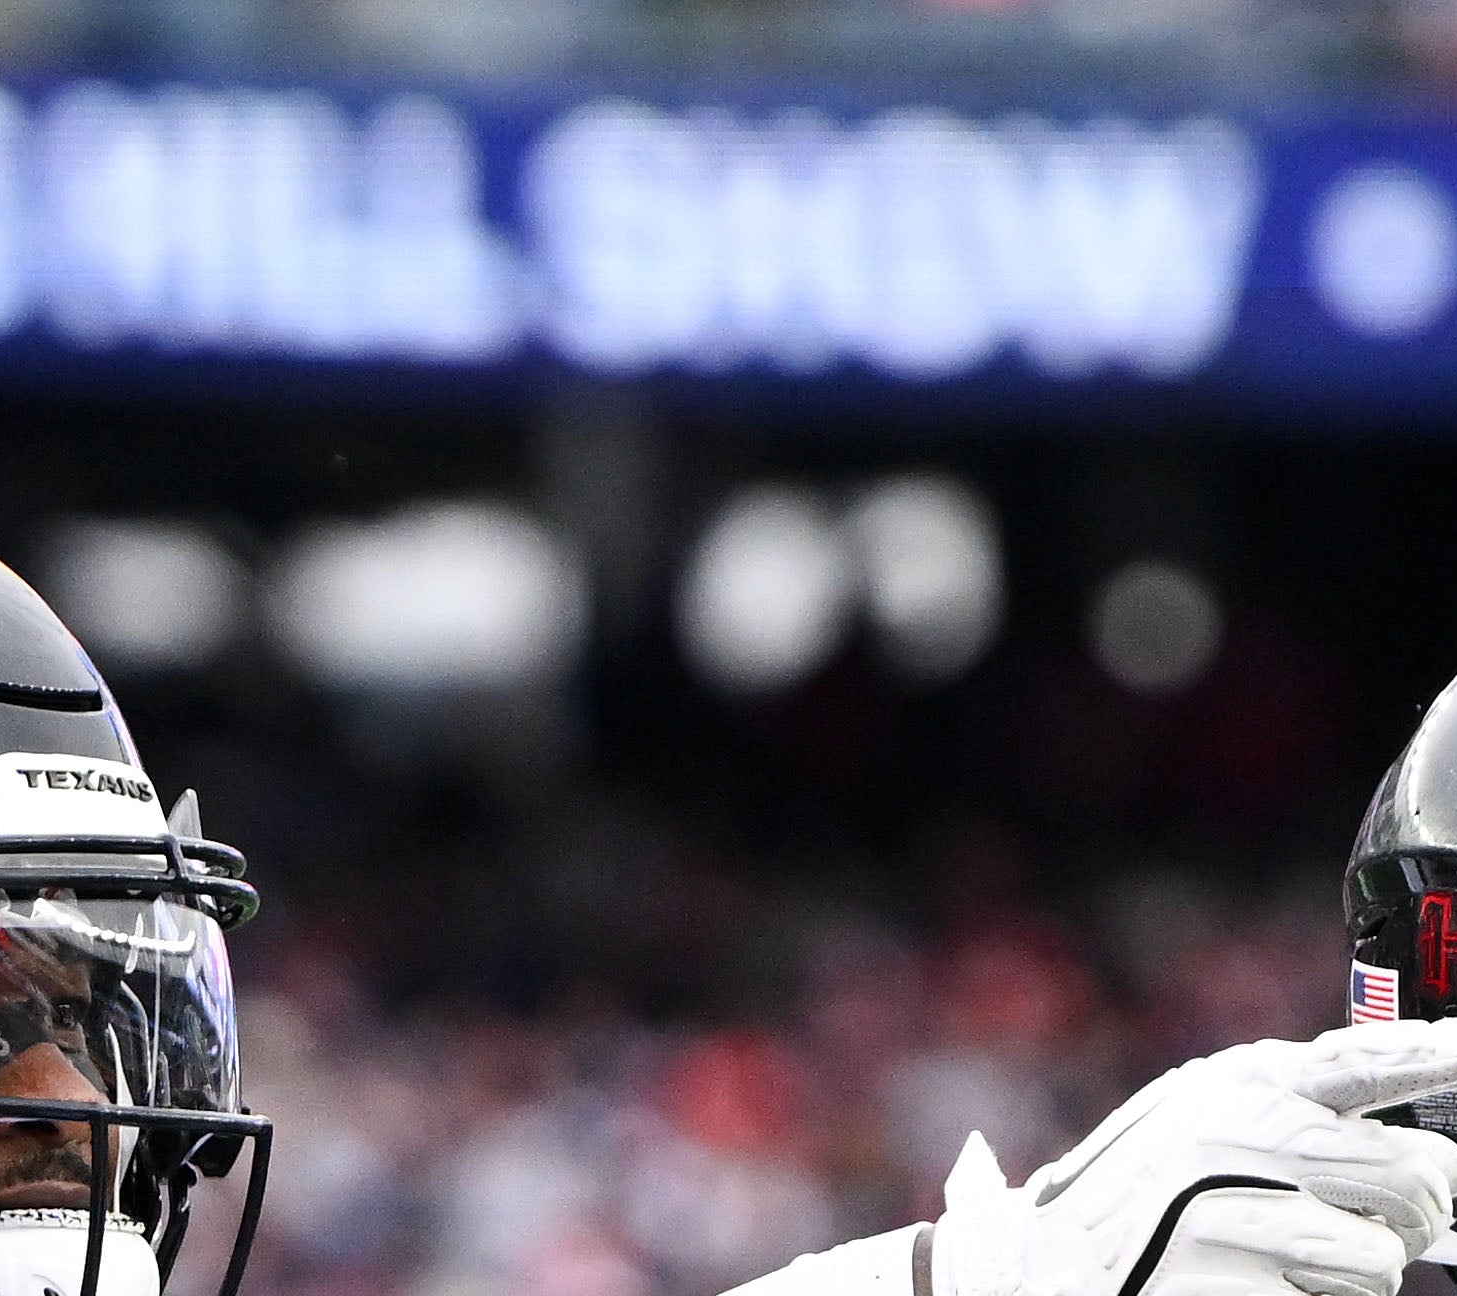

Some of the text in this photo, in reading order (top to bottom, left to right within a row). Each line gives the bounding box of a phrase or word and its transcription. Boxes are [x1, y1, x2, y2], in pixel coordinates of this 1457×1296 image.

[54, 80, 532, 356] HILL
[532, 98, 1252, 373] SHOW
[16, 768, 154, 802] TEXANS
